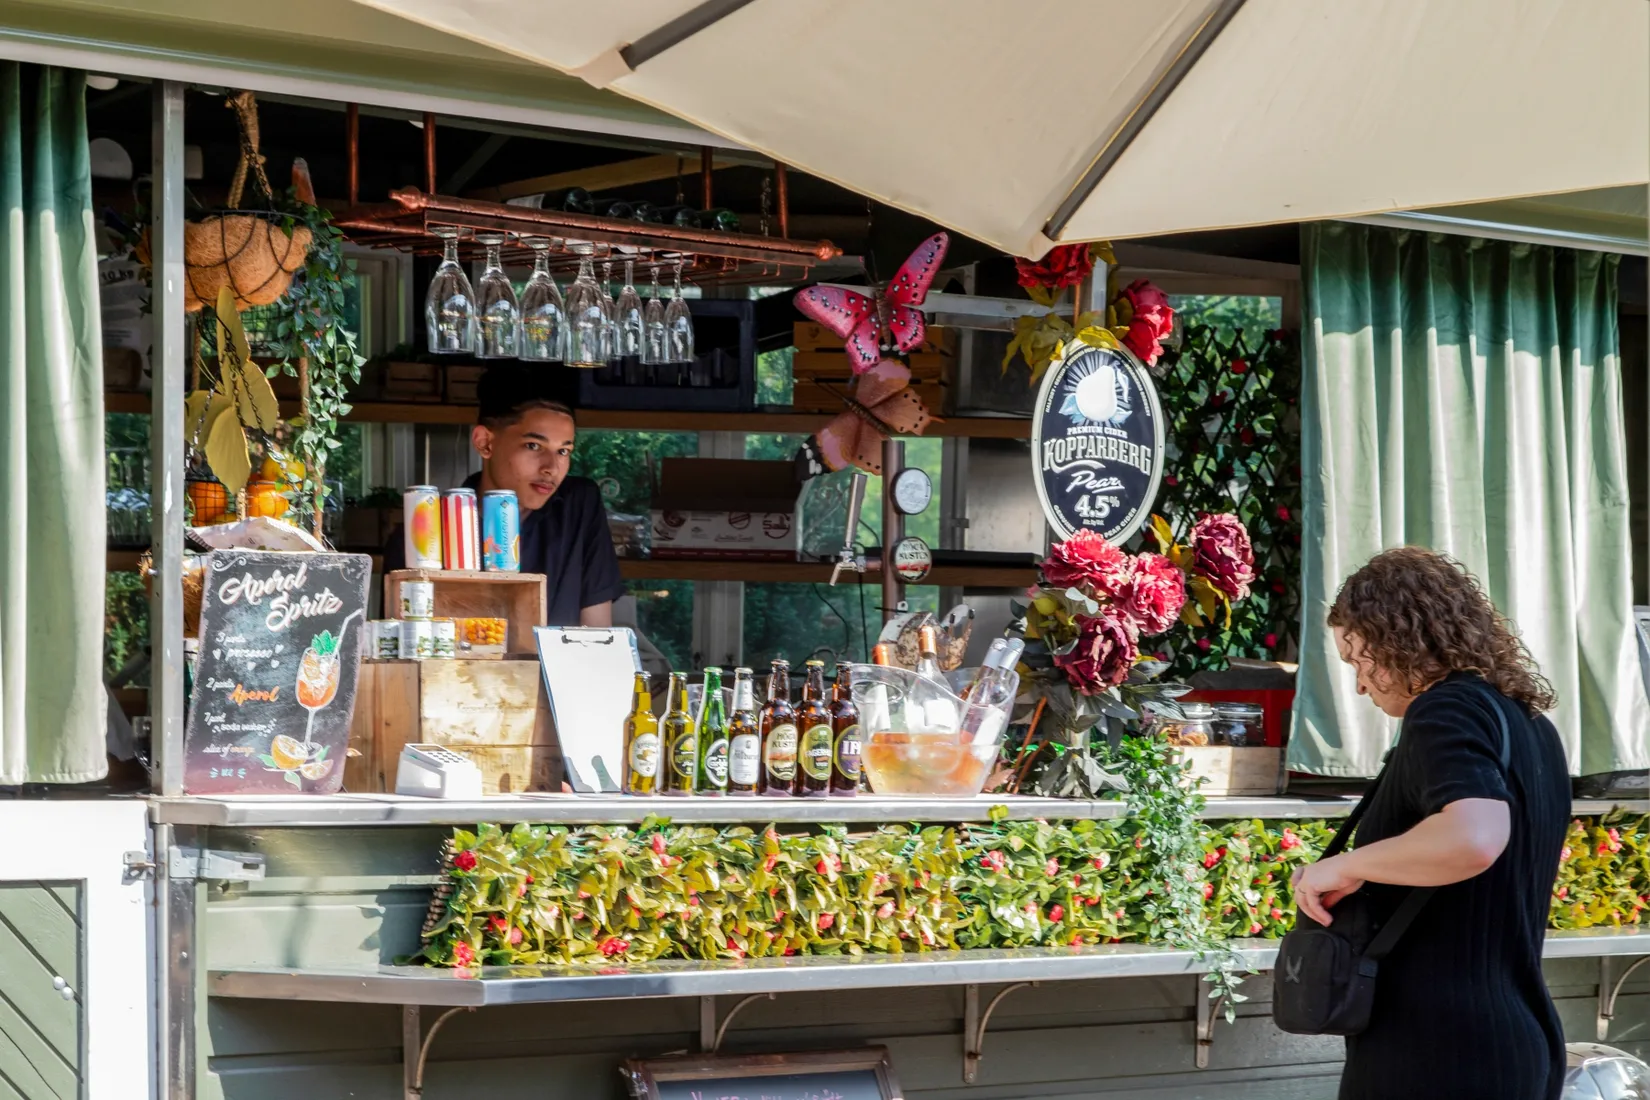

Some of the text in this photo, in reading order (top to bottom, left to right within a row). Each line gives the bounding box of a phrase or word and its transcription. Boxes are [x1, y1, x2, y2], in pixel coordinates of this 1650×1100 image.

[1066, 425, 1128, 439] PREMIUM CIDER
[1042, 435, 1151, 476] KOPPARBERG
[1066, 470, 1125, 494] Pear
[1074, 494, 1120, 519] 4.5%
[1103, 525, 1121, 538] PEAR
[1120, 507, 1137, 527] CIDER
[218, 561, 308, 606] Aperol
[265, 587, 343, 633] Spritz
[228, 683, 280, 706] Aperol
